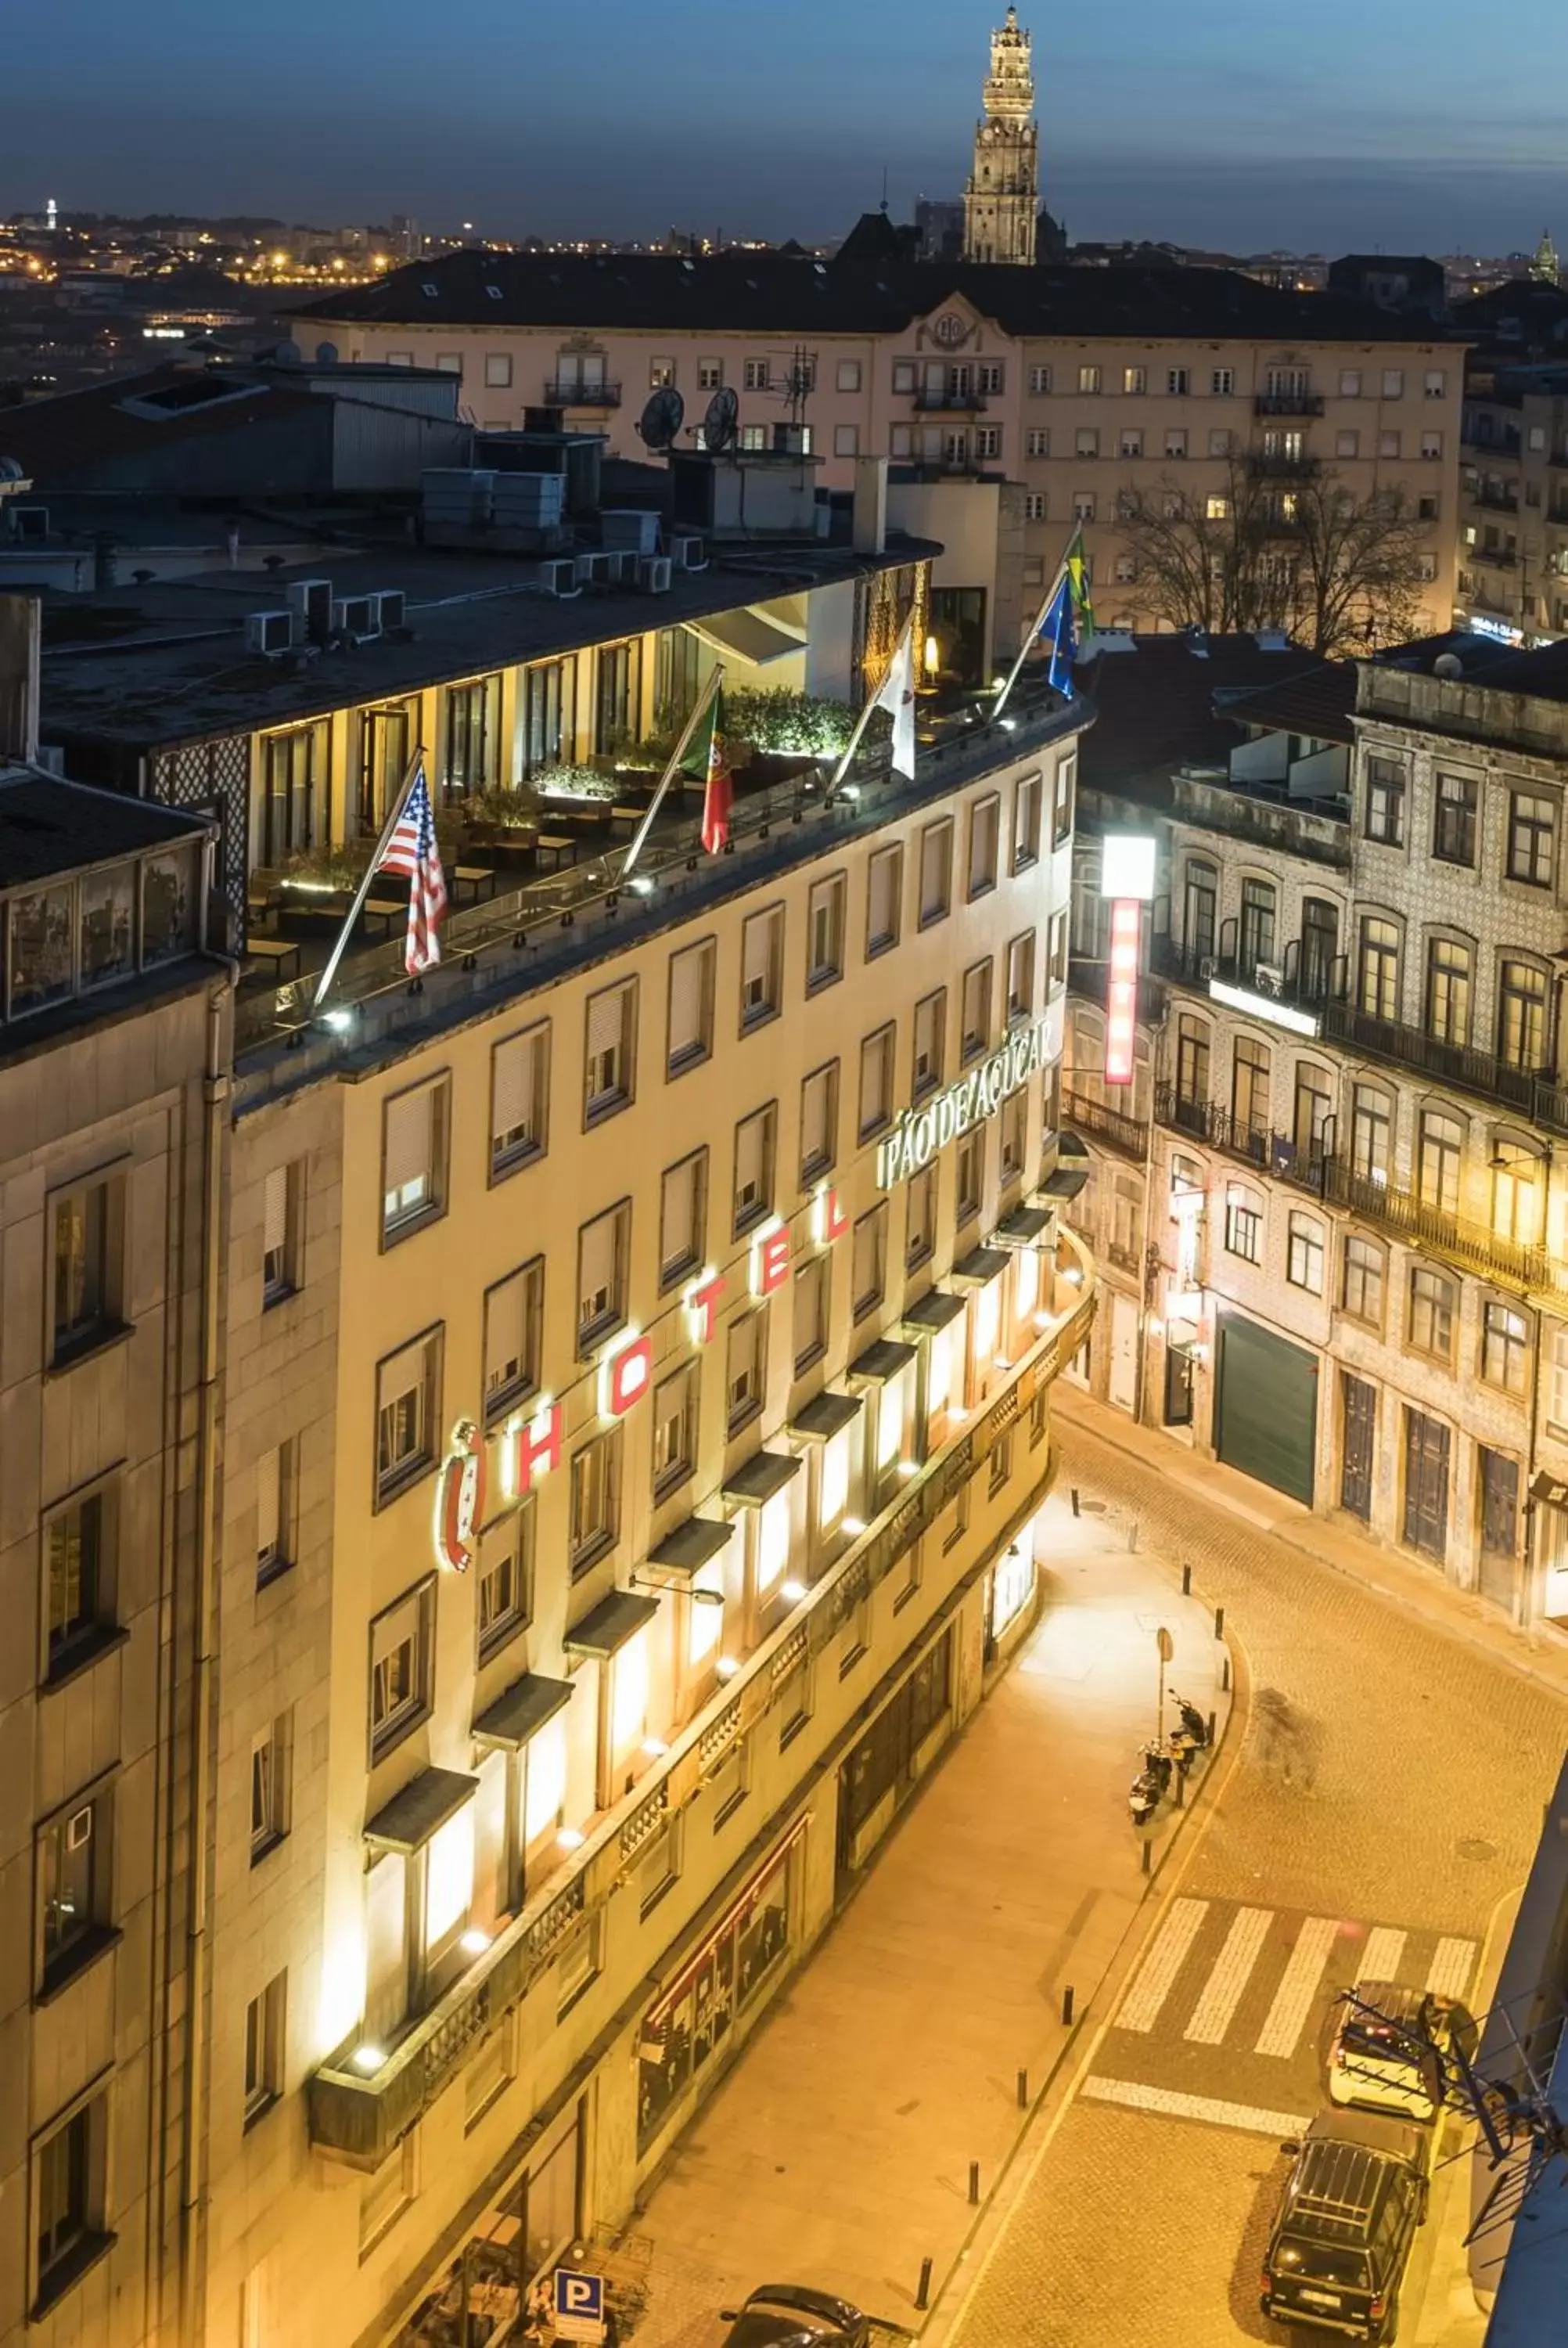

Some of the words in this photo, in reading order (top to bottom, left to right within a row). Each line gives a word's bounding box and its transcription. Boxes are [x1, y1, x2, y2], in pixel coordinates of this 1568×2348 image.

[512, 1187, 850, 1496] HOTEL
[879, 1110, 932, 1190] PÃO
[933, 1082, 969, 1148] DE
[566, 2278, 592, 2310] P
